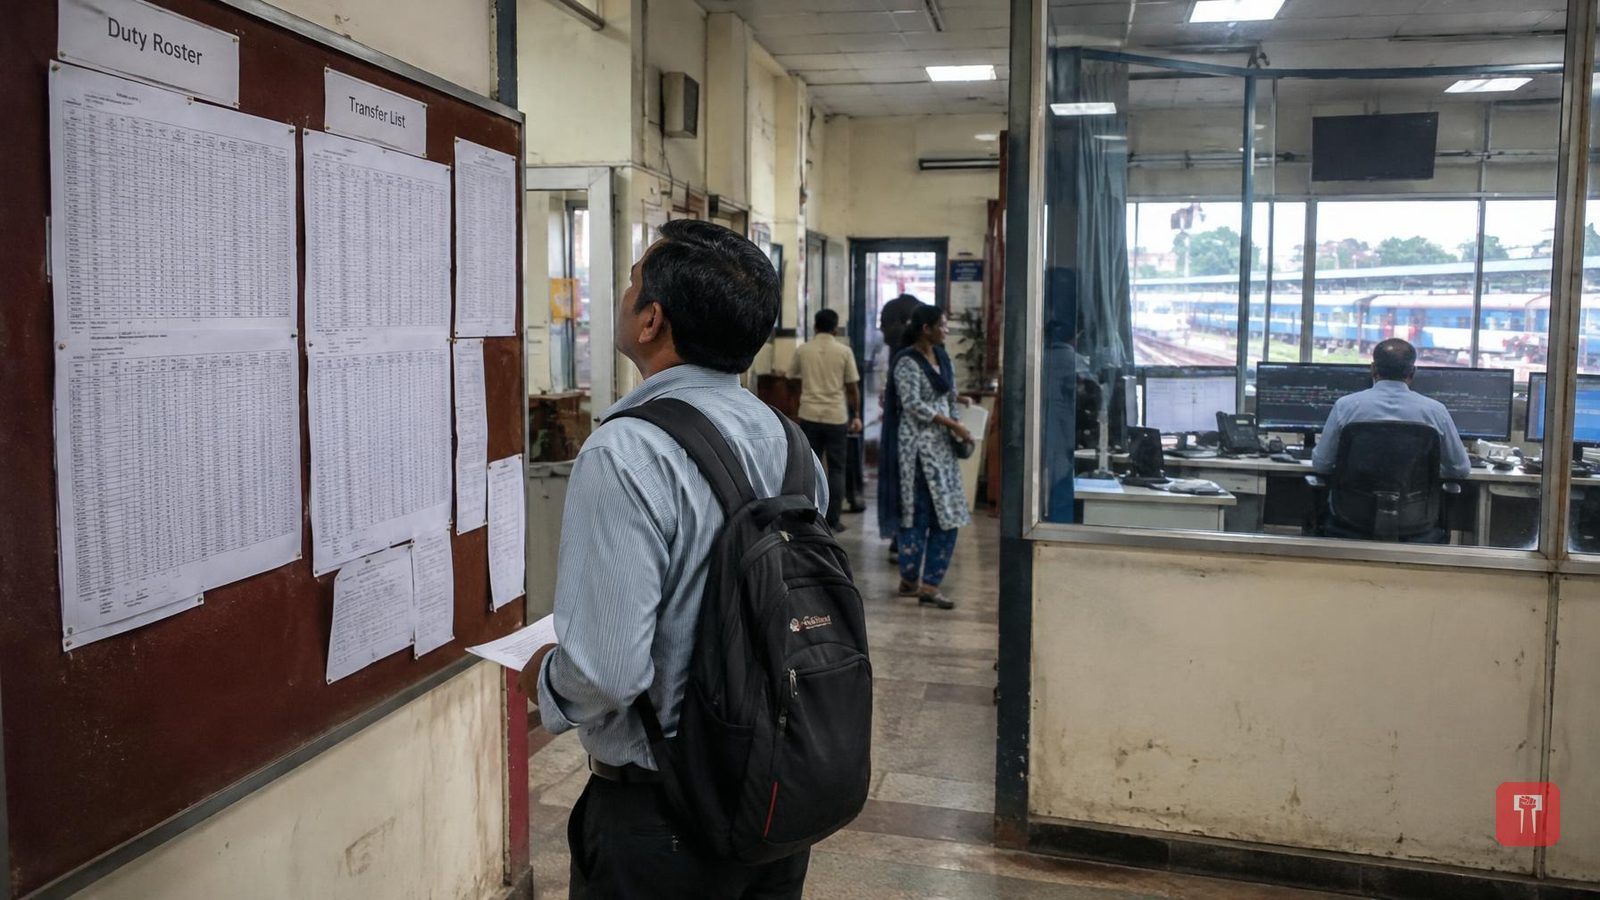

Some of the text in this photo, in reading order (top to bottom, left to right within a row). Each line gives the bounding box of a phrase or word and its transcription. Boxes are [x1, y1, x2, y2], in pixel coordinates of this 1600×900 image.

[107, 17, 203, 65] Duty Roster
[349, 96, 406, 128] Transfer List
